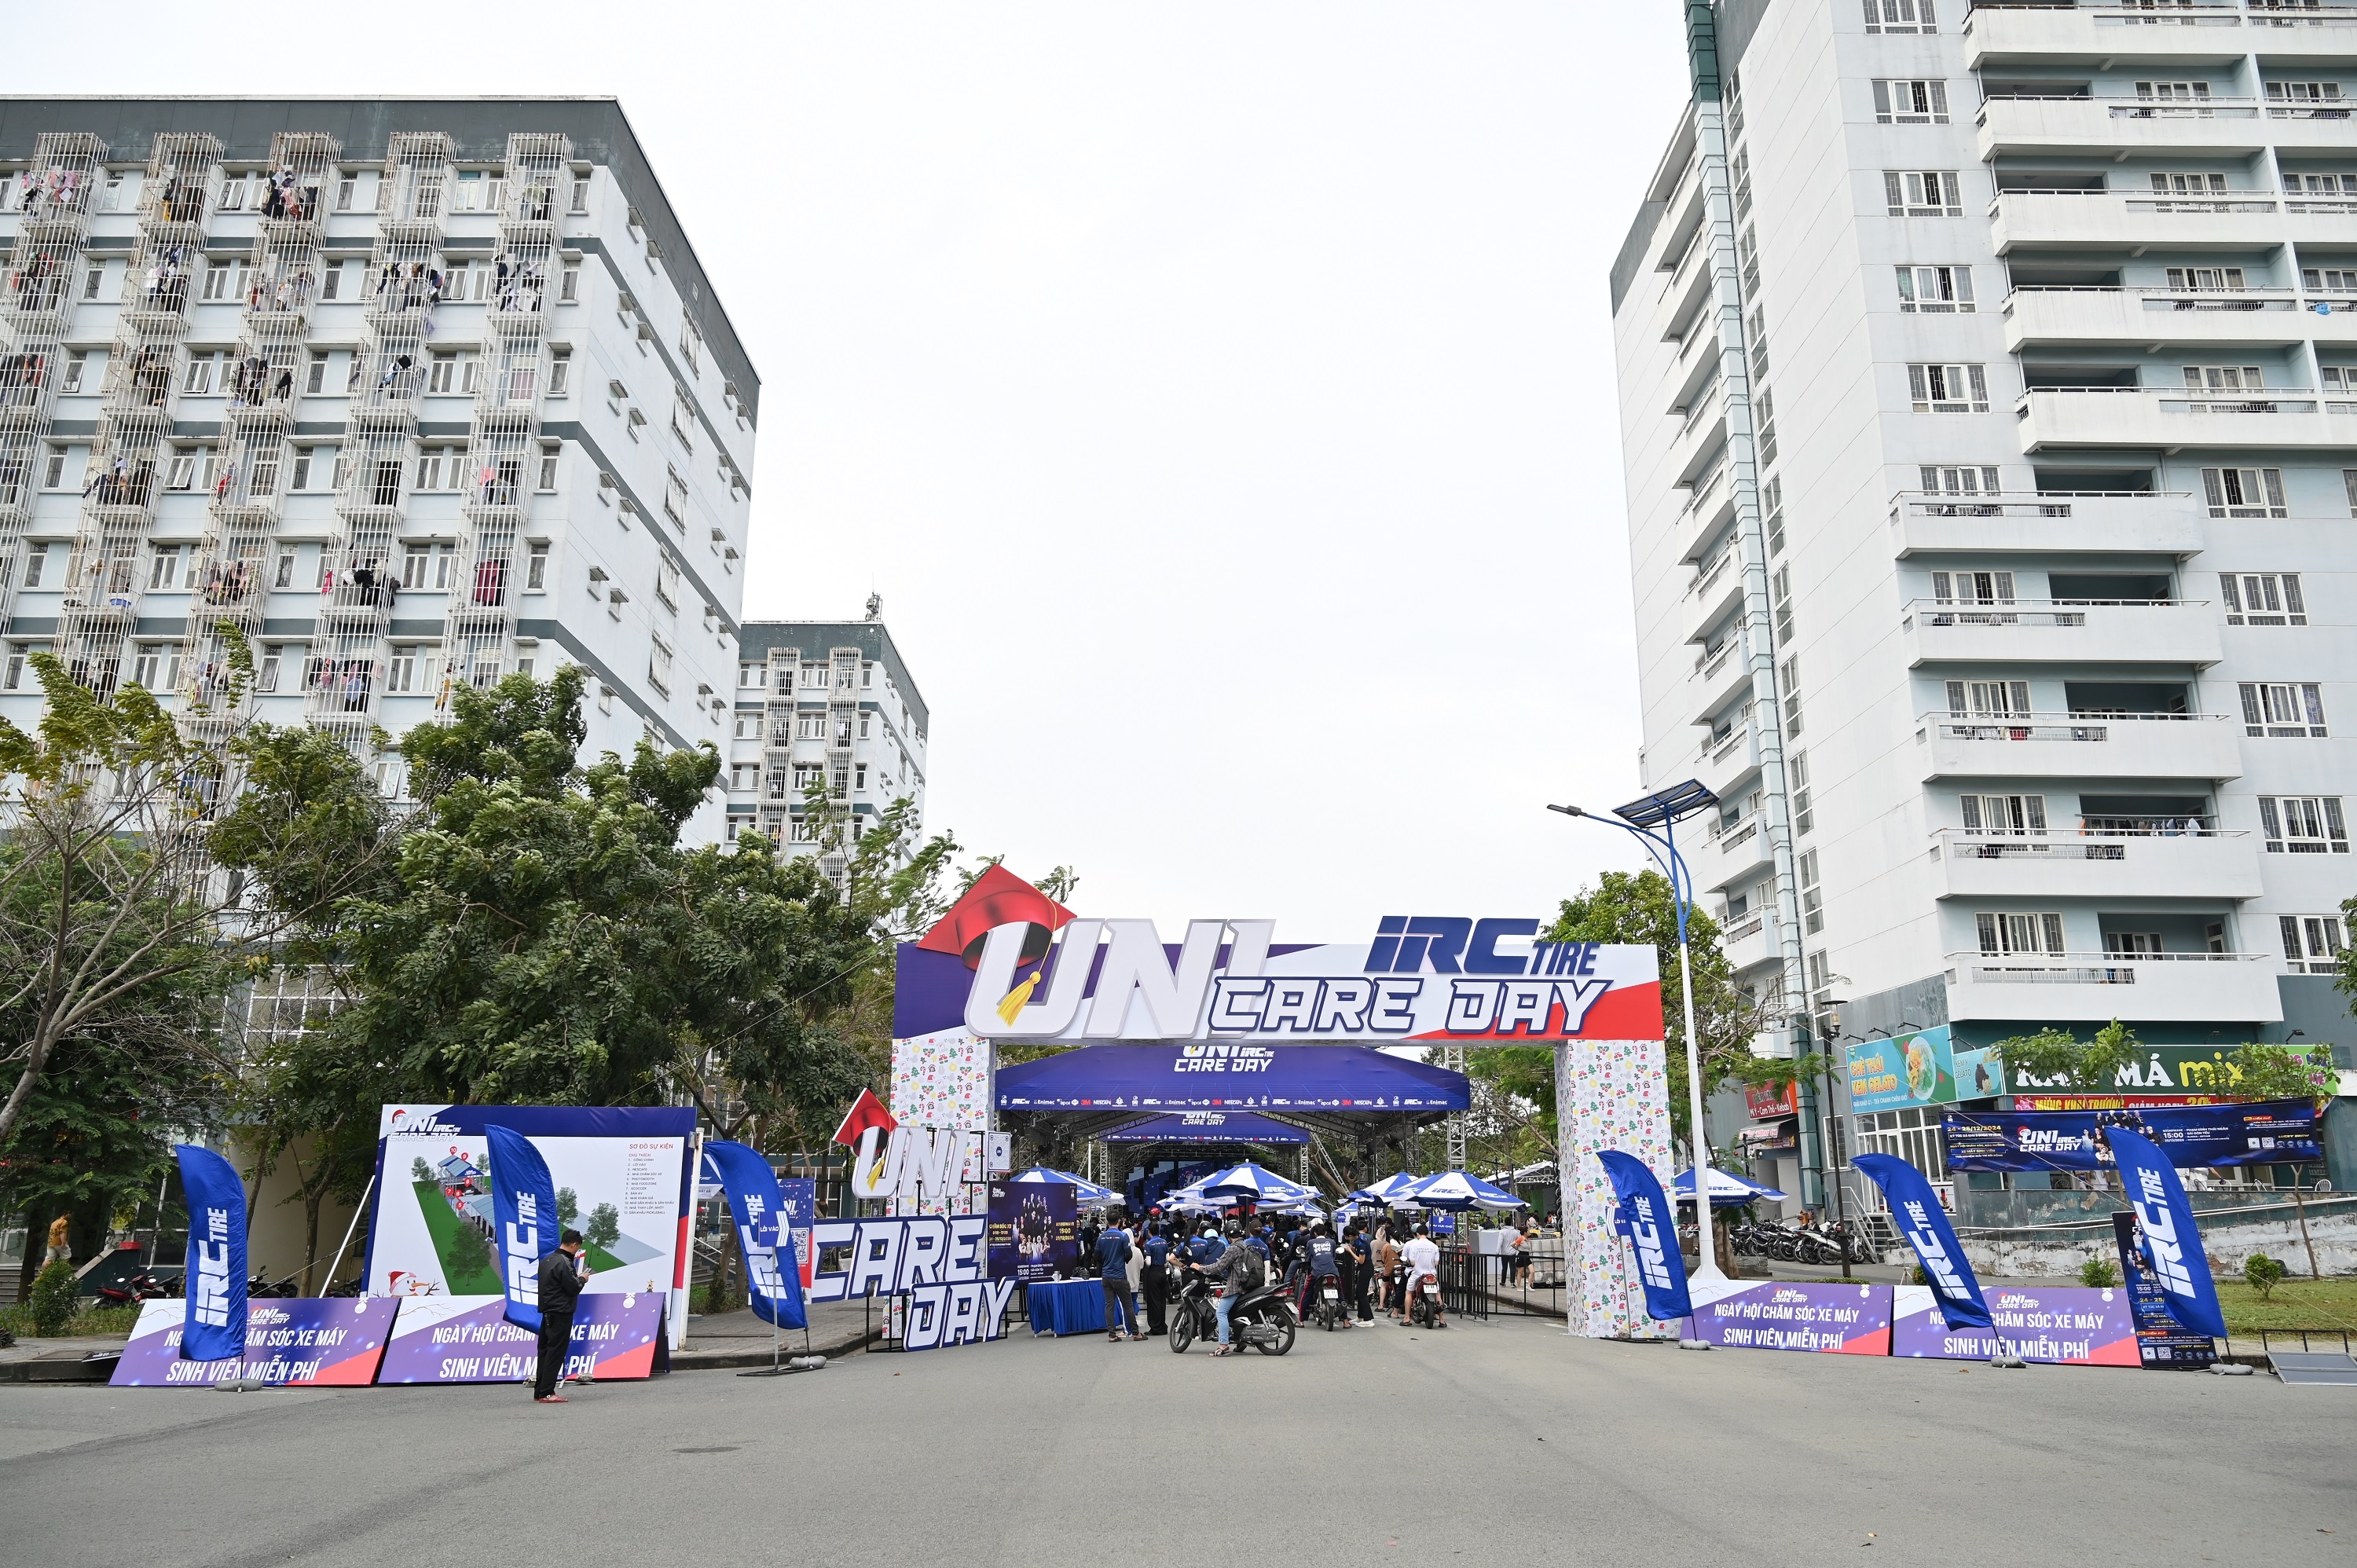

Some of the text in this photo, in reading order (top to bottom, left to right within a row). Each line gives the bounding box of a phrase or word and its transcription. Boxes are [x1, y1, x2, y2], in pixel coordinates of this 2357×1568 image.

[1363, 915, 1601, 975] IRC TIRE
[964, 918, 1277, 1039] UNI
[1208, 976, 1614, 1034] CARE DAY
[1175, 1059, 1273, 1072] CARE DAY
[1849, 1053, 1884, 1077] CHÈ THÁI
[2114, 1053, 2175, 1087] MÁ
[1851, 1074, 1897, 1096] KEM GELATO
[1776, 1102, 1790, 1112] Kebab
[388, 1133, 457, 1141] CARE DAY
[394, 1116, 438, 1132] UNI
[2022, 1130, 2058, 1144] UNI
[852, 1126, 970, 1199] UNI
[2137, 1167, 2168, 1206] TIRE
[517, 1191, 537, 1225] TIRE
[745, 1194, 764, 1225] TIRE
[1634, 1196, 1653, 1223] TIRE
[1904, 1200, 1932, 1231] TIRE
[207, 1207, 228, 1242] TIRE
[811, 1214, 988, 1302] CARE
[1631, 1221, 1673, 1290] IRC
[2132, 1200, 2195, 1299] IRC
[506, 1222, 540, 1306] IRC
[1908, 1229, 1972, 1299] IRC
[195, 1240, 229, 1327] IRC
[1714, 1302, 1860, 1323] NGÀY HỘI CHĂM SÓC XE MÁY
[2000, 1295, 2025, 1303] UNI
[251, 1308, 280, 1319] UNI
[904, 1276, 1019, 1351] DAY
[2027, 1310, 2051, 1329] SÓC
[2055, 1314, 2071, 1328] XE
[2074, 1312, 2104, 1329] MÁY
[268, 1327, 348, 1346] SÓC XE MÁY
[431, 1321, 620, 1345] NGÀY HỘI XE MÁY
[1723, 1326, 1846, 1350] SINH VIÊN MIỄN PHÍ
[1944, 1335, 2089, 1359] SINH VIÊN MIỄN PHÍ
[166, 1354, 324, 1382] SINH VIÊN MIỄN PHÍ
[439, 1357, 478, 1378] SINH
[484, 1353, 522, 1376] VIÊN
[567, 1351, 599, 1375] PHÍ
